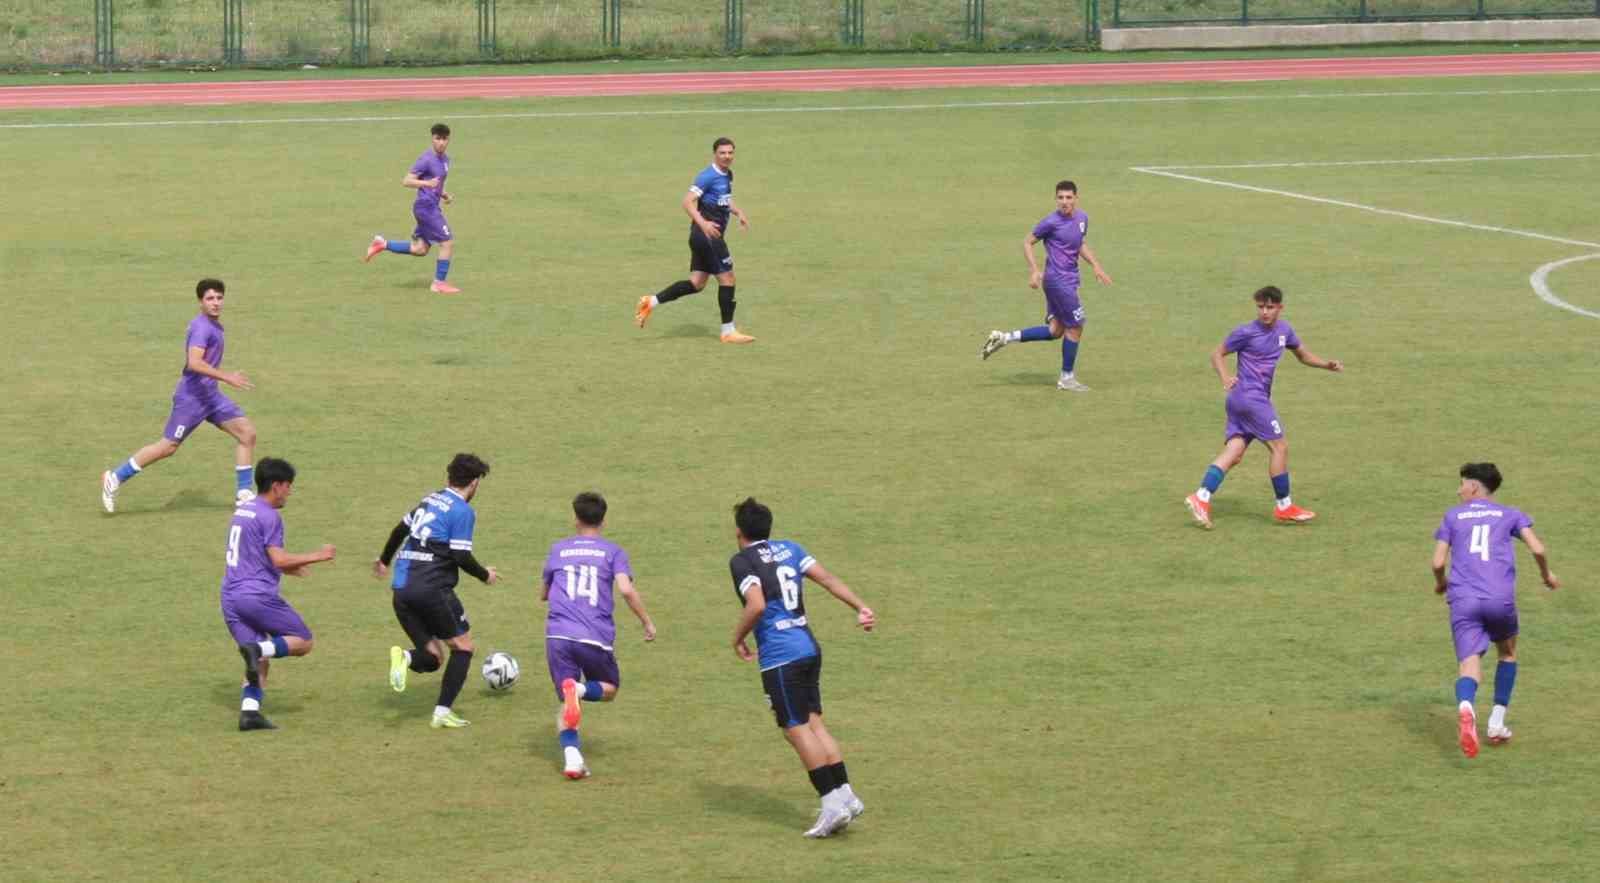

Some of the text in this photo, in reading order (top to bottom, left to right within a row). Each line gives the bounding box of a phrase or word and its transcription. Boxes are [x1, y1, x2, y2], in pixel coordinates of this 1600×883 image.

[173, 424, 186, 439] 8
[226, 525, 242, 567] 9
[1470, 525, 1490, 561] 4
[563, 565, 598, 606] 14
[776, 566, 798, 610] 6
